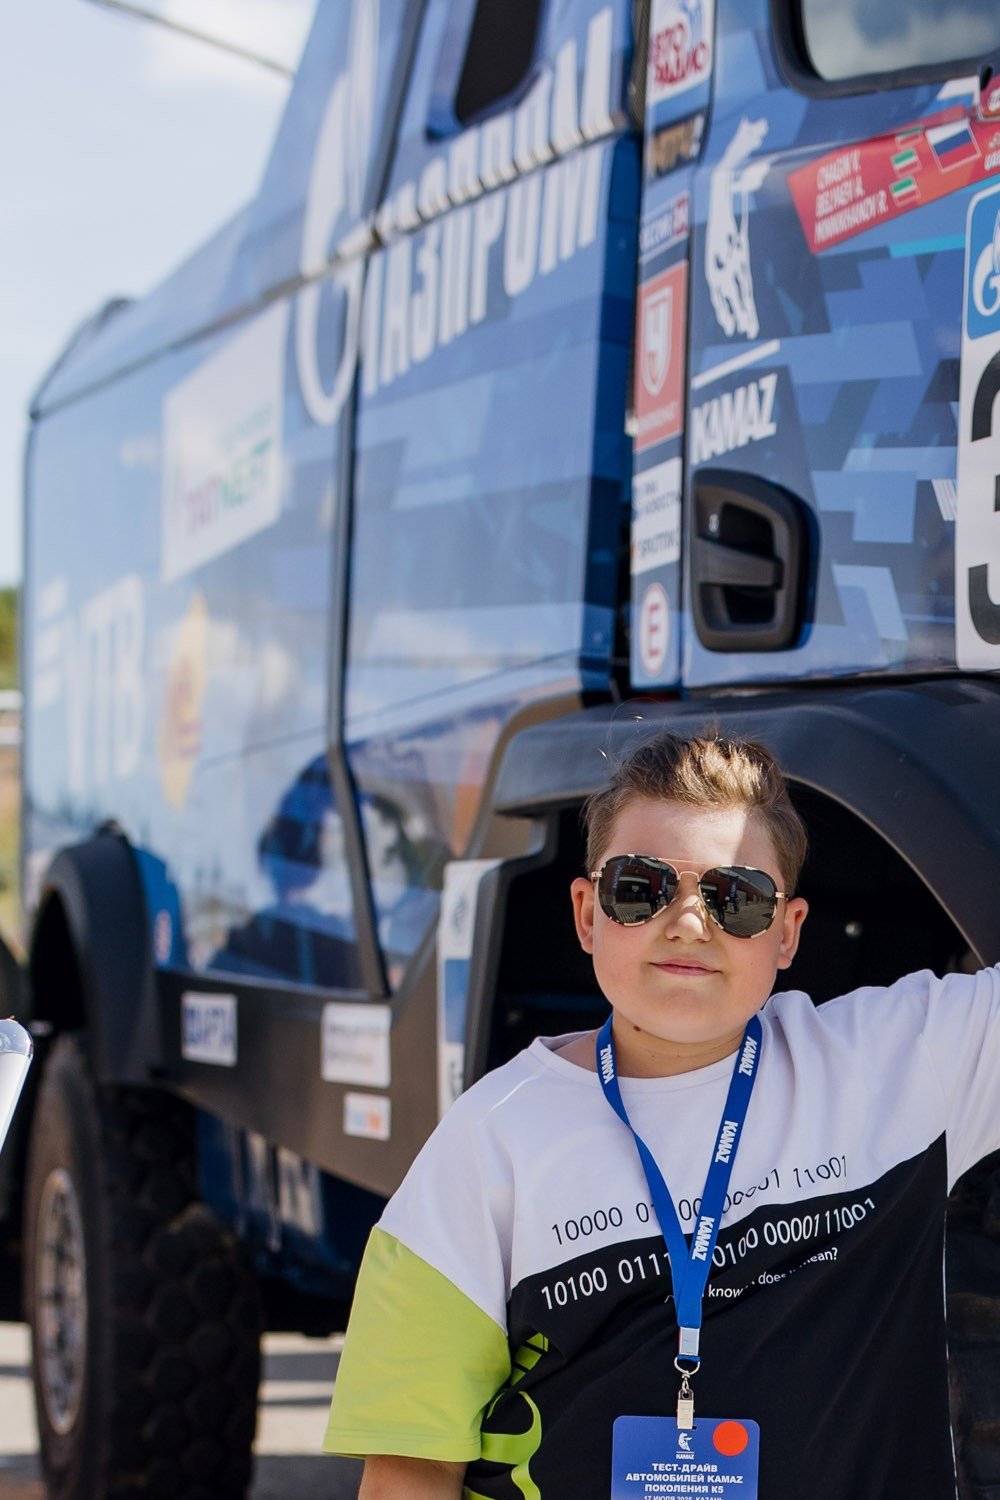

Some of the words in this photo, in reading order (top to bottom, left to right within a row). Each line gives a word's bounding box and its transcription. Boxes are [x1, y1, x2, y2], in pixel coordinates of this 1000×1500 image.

[690, 372, 778, 466] KAMAZ
[600, 1043, 615, 1085] KAMAZ
[738, 1036, 758, 1077] KAMAZ
[714, 1120, 738, 1164] KAMAZ
[552, 1207, 623, 1246] 10000
[793, 1155, 847, 1189] 11001
[691, 1216, 715, 1262] KAMAZ
[541, 1266, 608, 1310] 10100
[708, 1284, 744, 1298] know
[625, 1472, 705, 1483] АВТОМОБИЛЕЙ
[645, 1483, 708, 1493] ПОКОЛЕНИЯ
[652, 1462, 718, 1473] ТЕСТ-ДРАЙВ
